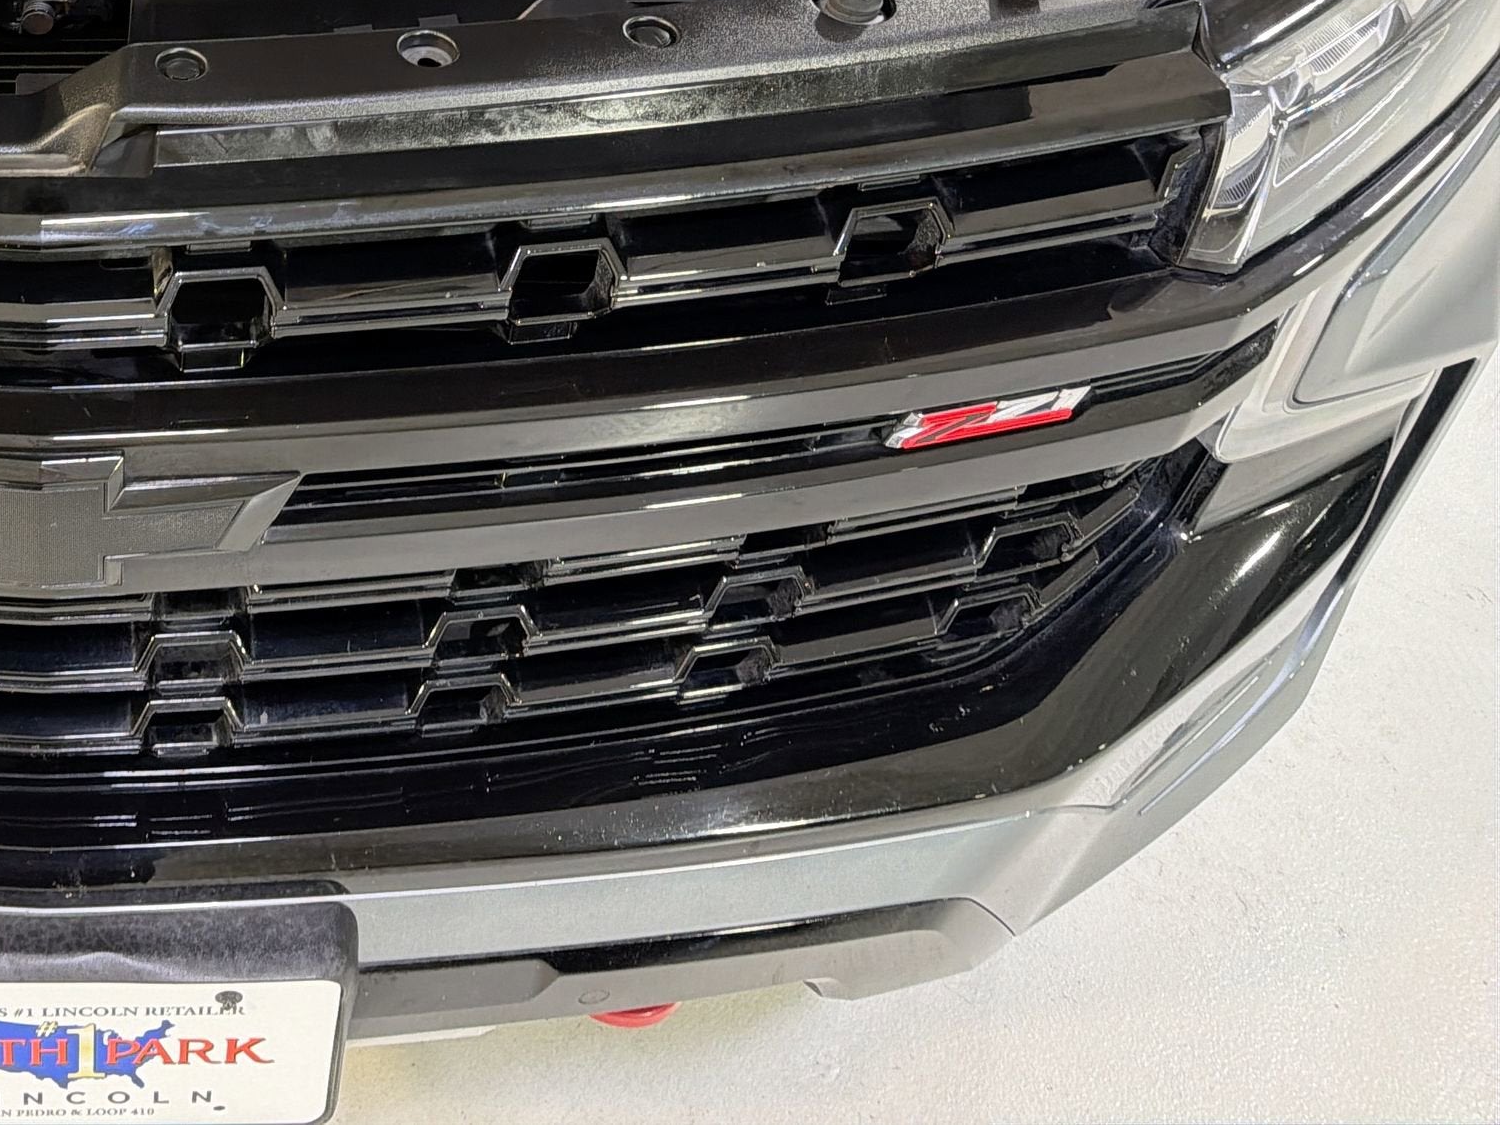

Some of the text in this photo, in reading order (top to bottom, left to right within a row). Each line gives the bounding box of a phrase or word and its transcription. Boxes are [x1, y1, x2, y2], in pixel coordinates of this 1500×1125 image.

[896, 385, 1092, 450] Z71
[13, 1007, 33, 1018] #1
[42, 1006, 139, 1018] LINCOLN
[106, 1037, 276, 1066] PARK
[16, 1107, 68, 1117] PEDRO
[70, 1107, 82, 1117] &
[86, 1106, 128, 1117] LOOP
[130, 1107, 155, 1117] 410
